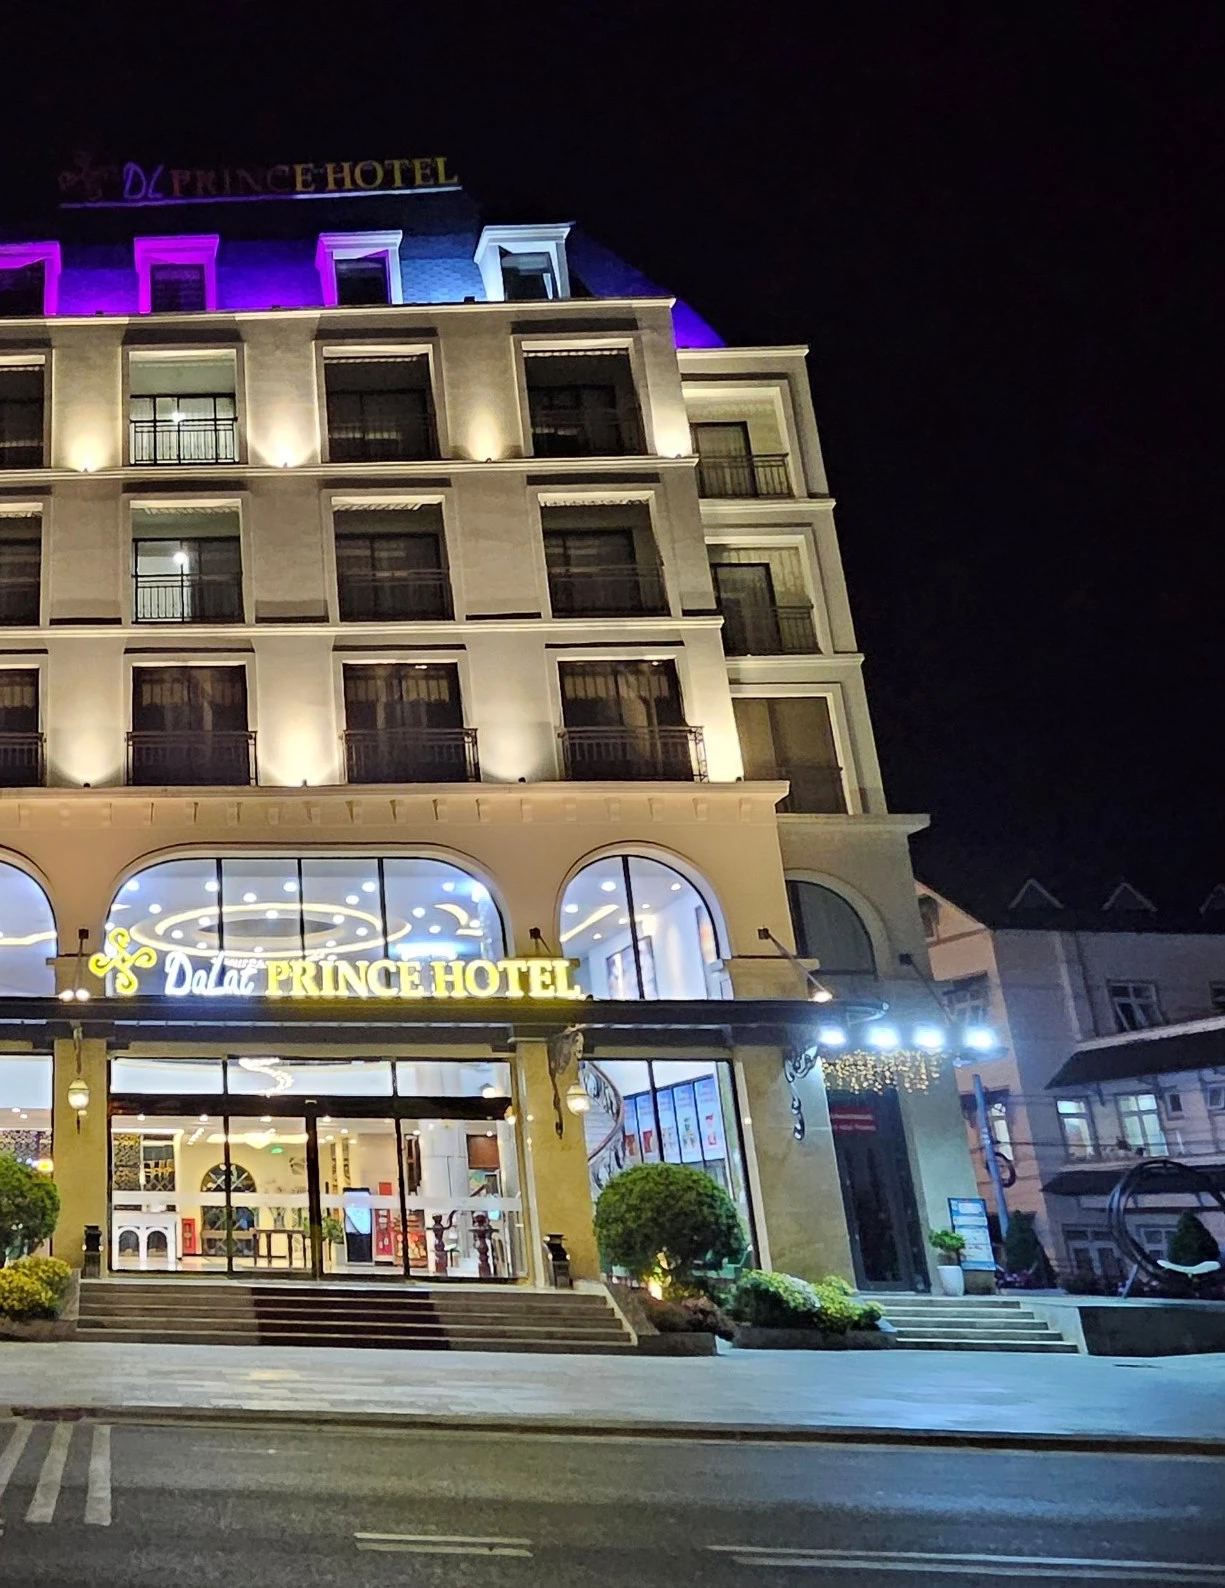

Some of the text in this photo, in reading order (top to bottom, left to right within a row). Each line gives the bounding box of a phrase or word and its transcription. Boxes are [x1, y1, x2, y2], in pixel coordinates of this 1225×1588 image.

[169, 162, 316, 197] PRINCE
[325, 155, 460, 189] HOTEL
[265, 959, 422, 998] PRINCE
[433, 958, 582, 999] HOTEL
